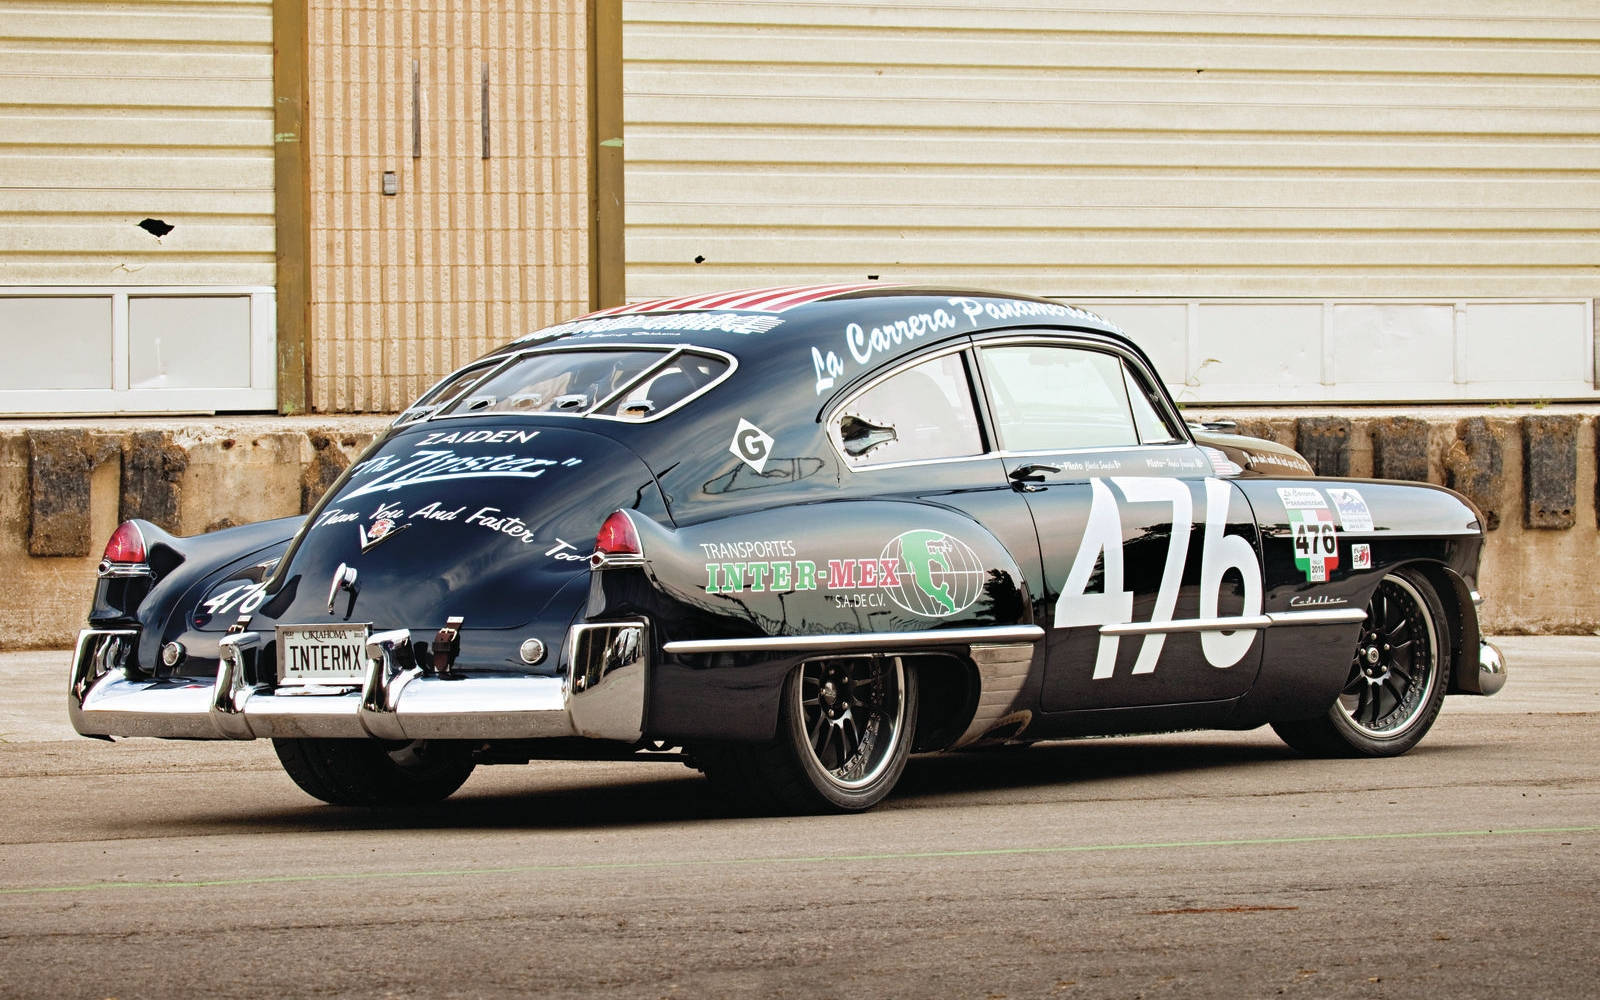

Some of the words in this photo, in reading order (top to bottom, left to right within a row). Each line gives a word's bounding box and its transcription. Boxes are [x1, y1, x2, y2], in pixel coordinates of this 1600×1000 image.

[810, 346, 844, 395] La
[846, 308, 956, 364] Carrera
[415, 430, 541, 447] ZAIDEN
[736, 428, 767, 462] G
[311, 508, 360, 530] Than
[369, 501, 404, 520] You
[408, 501, 467, 521] And
[464, 506, 534, 543] Faster
[700, 540, 796, 560] TRANSPORTES
[1295, 525, 1336, 555] 476
[705, 558, 901, 594] INTER-MEX
[1053, 476, 1262, 680] 476
[1311, 565, 1325, 574] 2010
[203, 576, 275, 614] 476
[302, 630, 348, 643] OKLAHOMA
[290, 645, 362, 671] INTERMX
